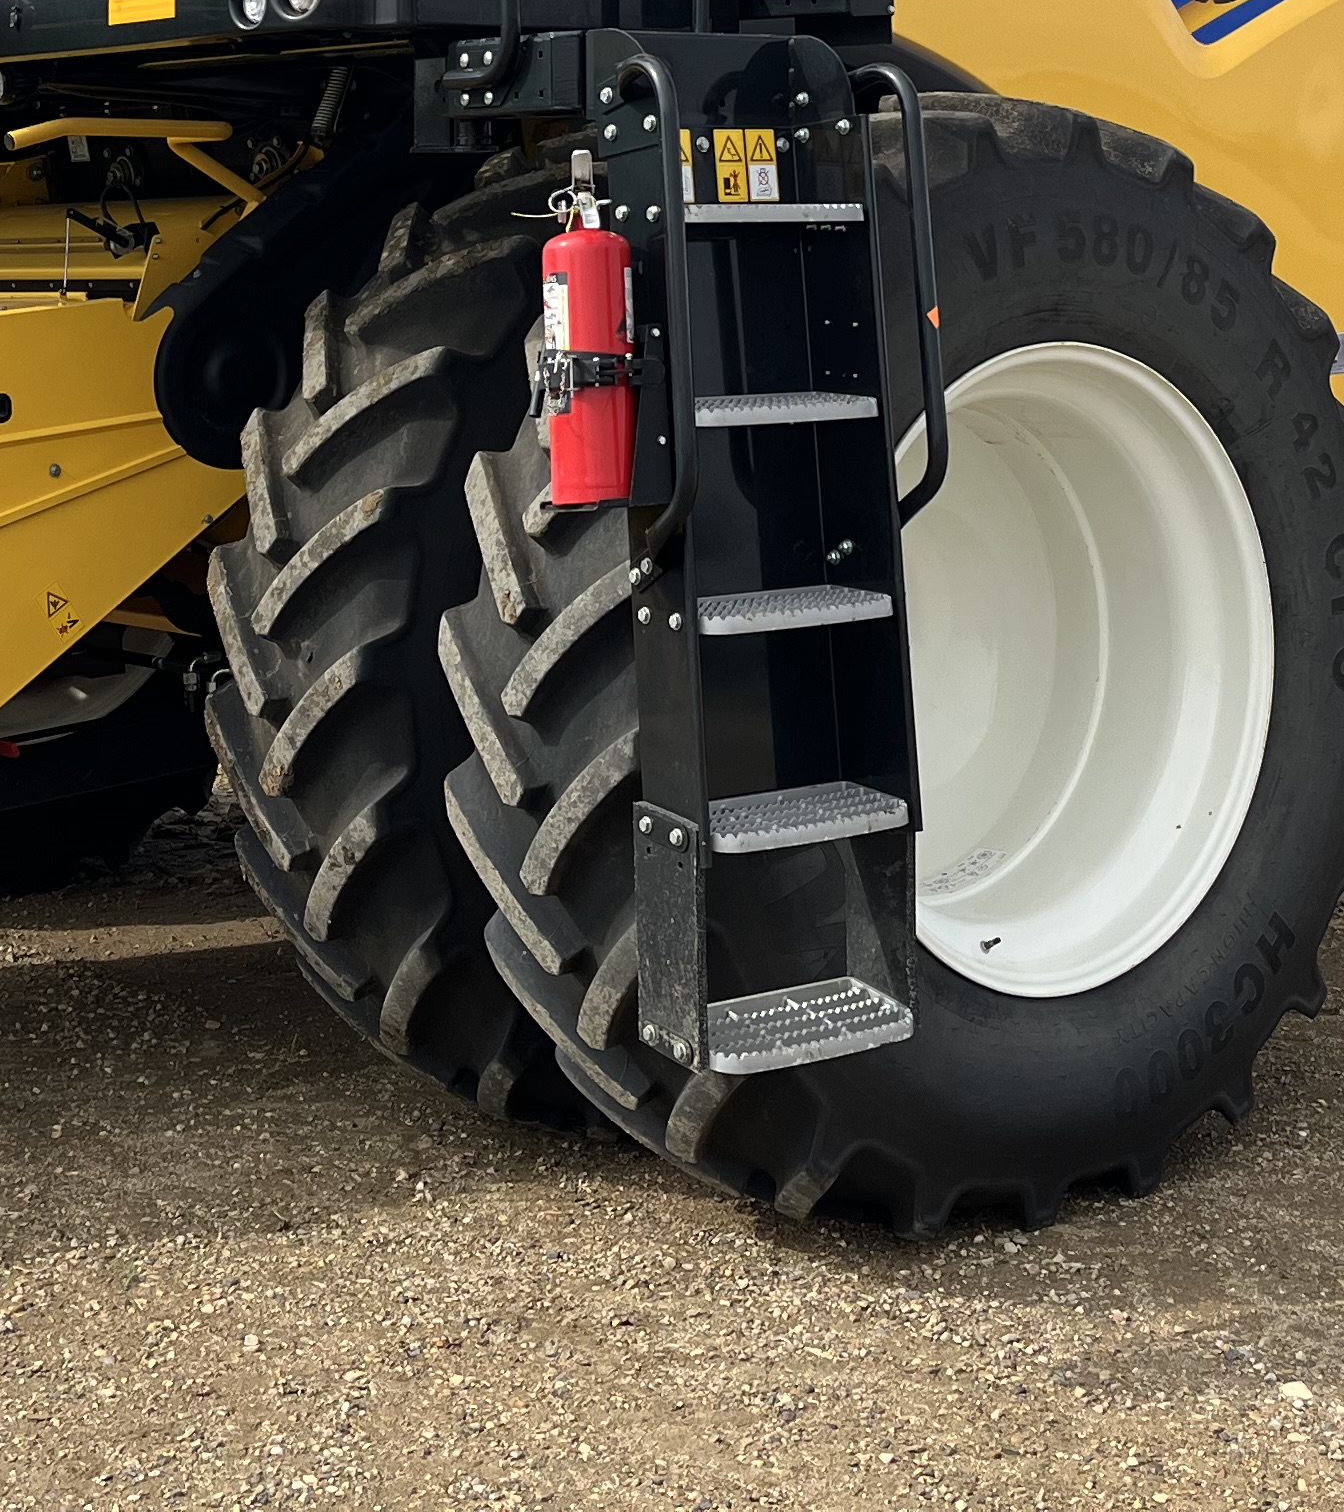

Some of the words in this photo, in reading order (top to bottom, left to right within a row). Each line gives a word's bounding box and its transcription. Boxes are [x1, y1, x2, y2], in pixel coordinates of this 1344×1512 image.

[961, 212, 1038, 282] VF
[1057, 212, 1241, 332] 580/85
[1256, 338, 1292, 402] R
[1291, 412, 1337, 500] 42
